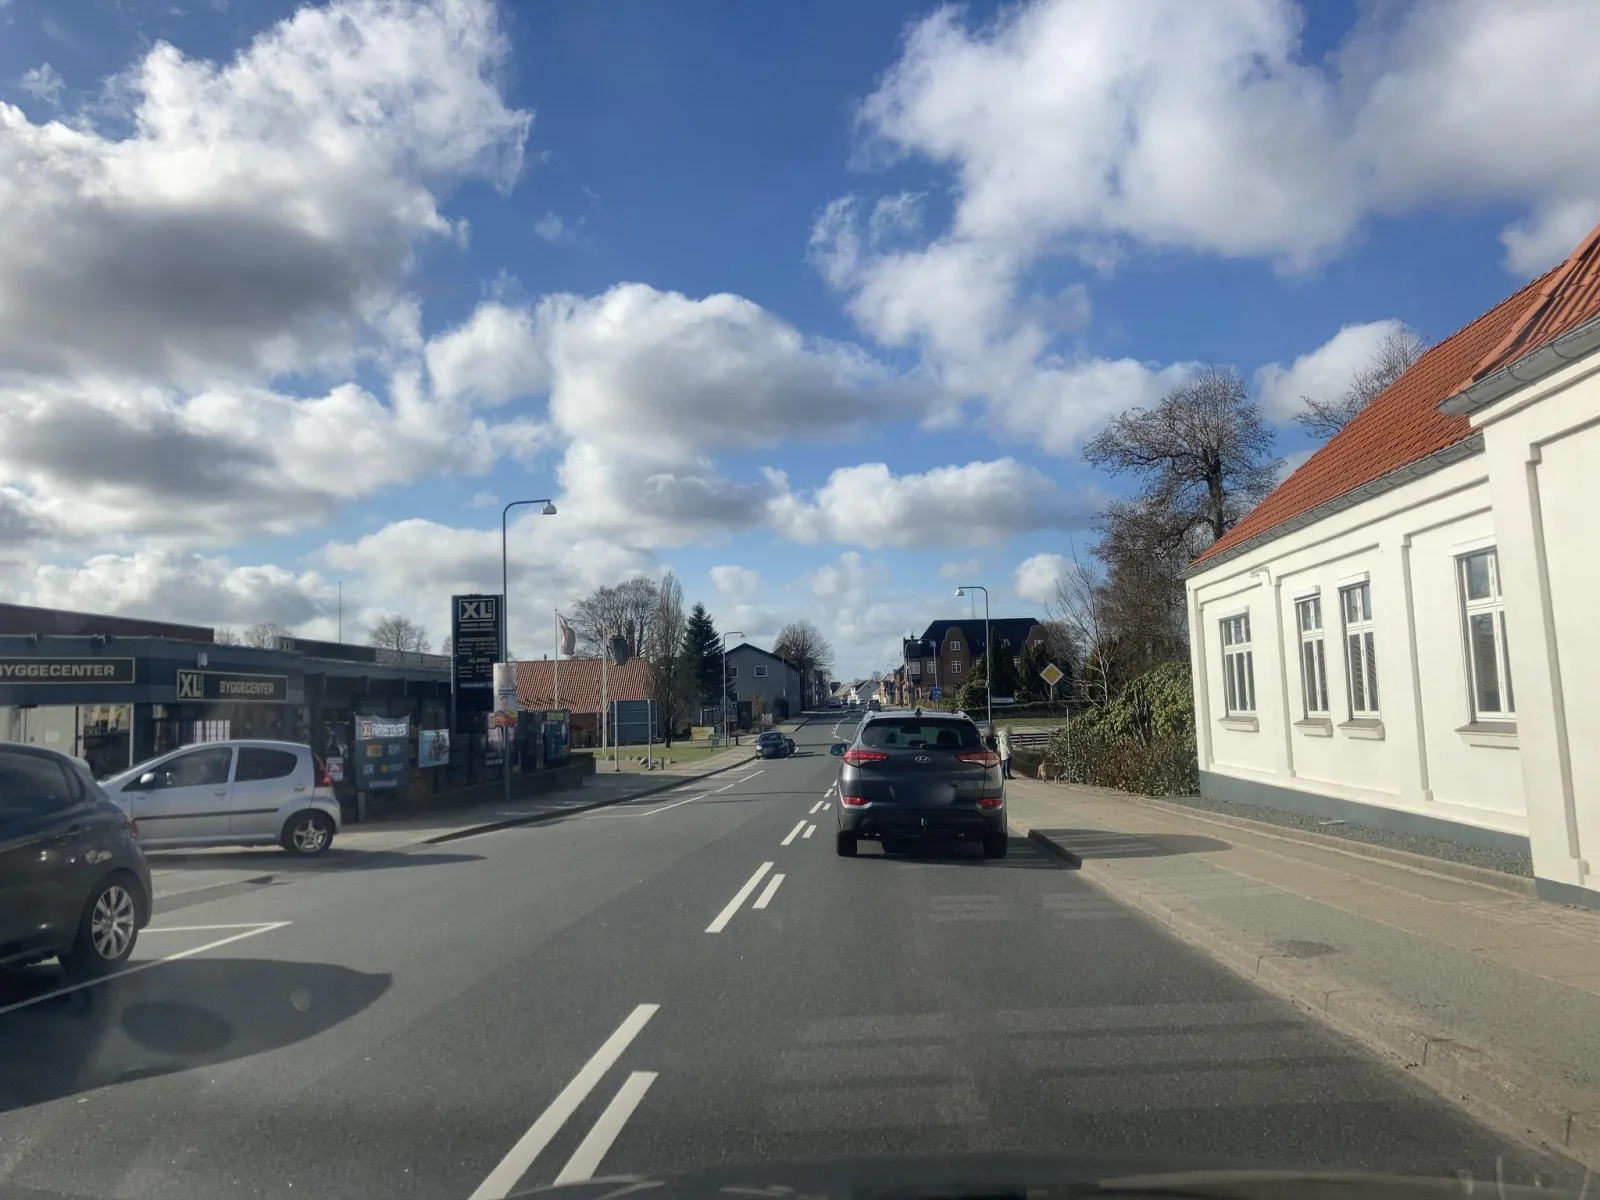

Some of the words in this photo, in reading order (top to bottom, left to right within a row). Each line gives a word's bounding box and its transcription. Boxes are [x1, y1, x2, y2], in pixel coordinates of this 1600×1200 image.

[462, 601, 493, 619] XL
[0, 664, 115, 677] YGGECENTER
[180, 674, 202, 697] XL
[220, 680, 274, 694] BYGGECENTER
